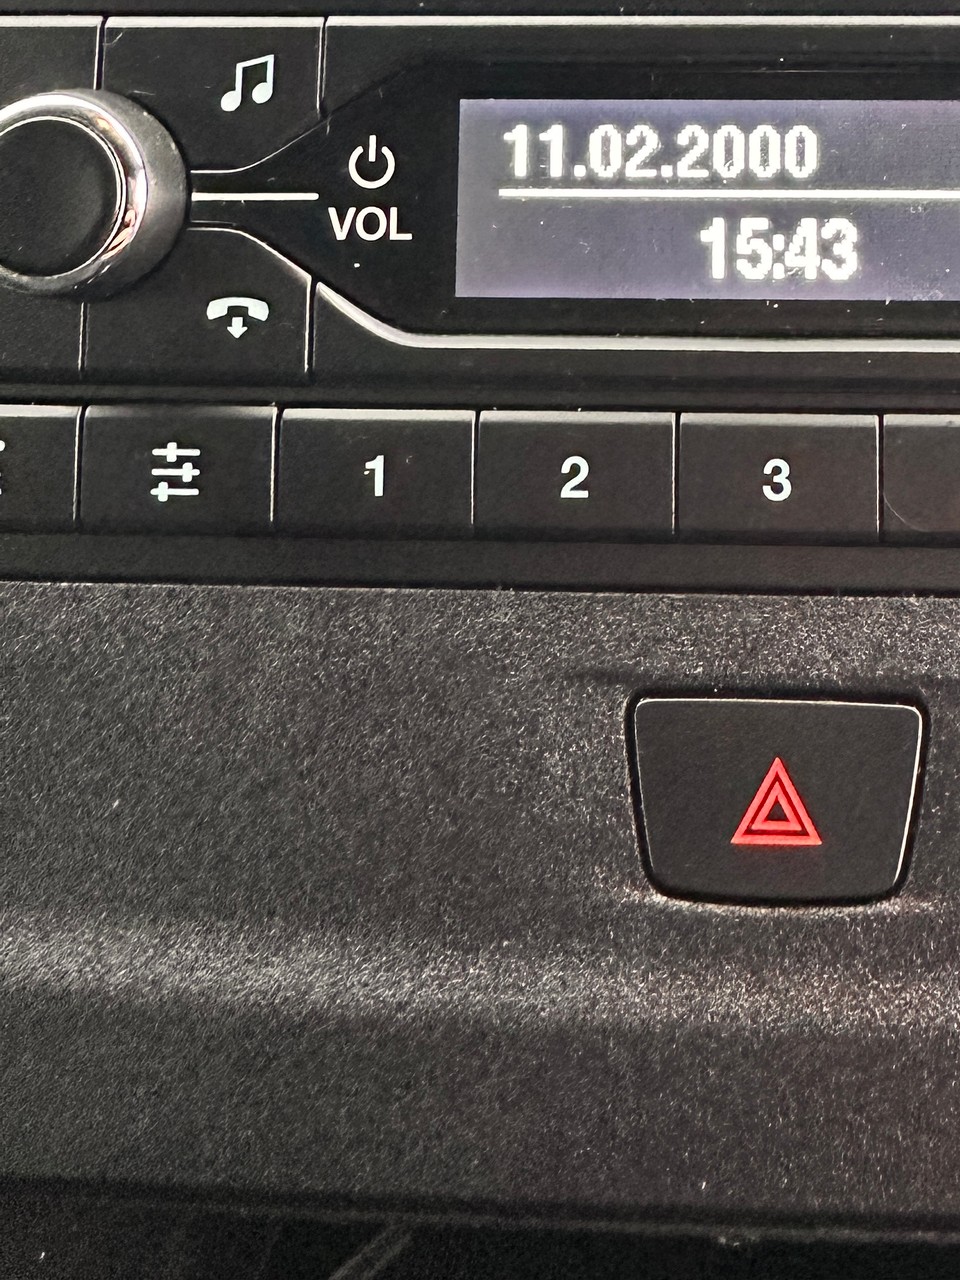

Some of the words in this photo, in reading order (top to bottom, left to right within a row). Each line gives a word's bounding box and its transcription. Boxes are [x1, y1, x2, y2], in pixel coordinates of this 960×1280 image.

[503, 123, 819, 180] 11.02.2000
[327, 206, 413, 242] VOL
[700, 215, 860, 282] 15:43
[363, 454, 385, 497] 1
[560, 455, 589, 499] 2
[762, 458, 792, 502] 3
